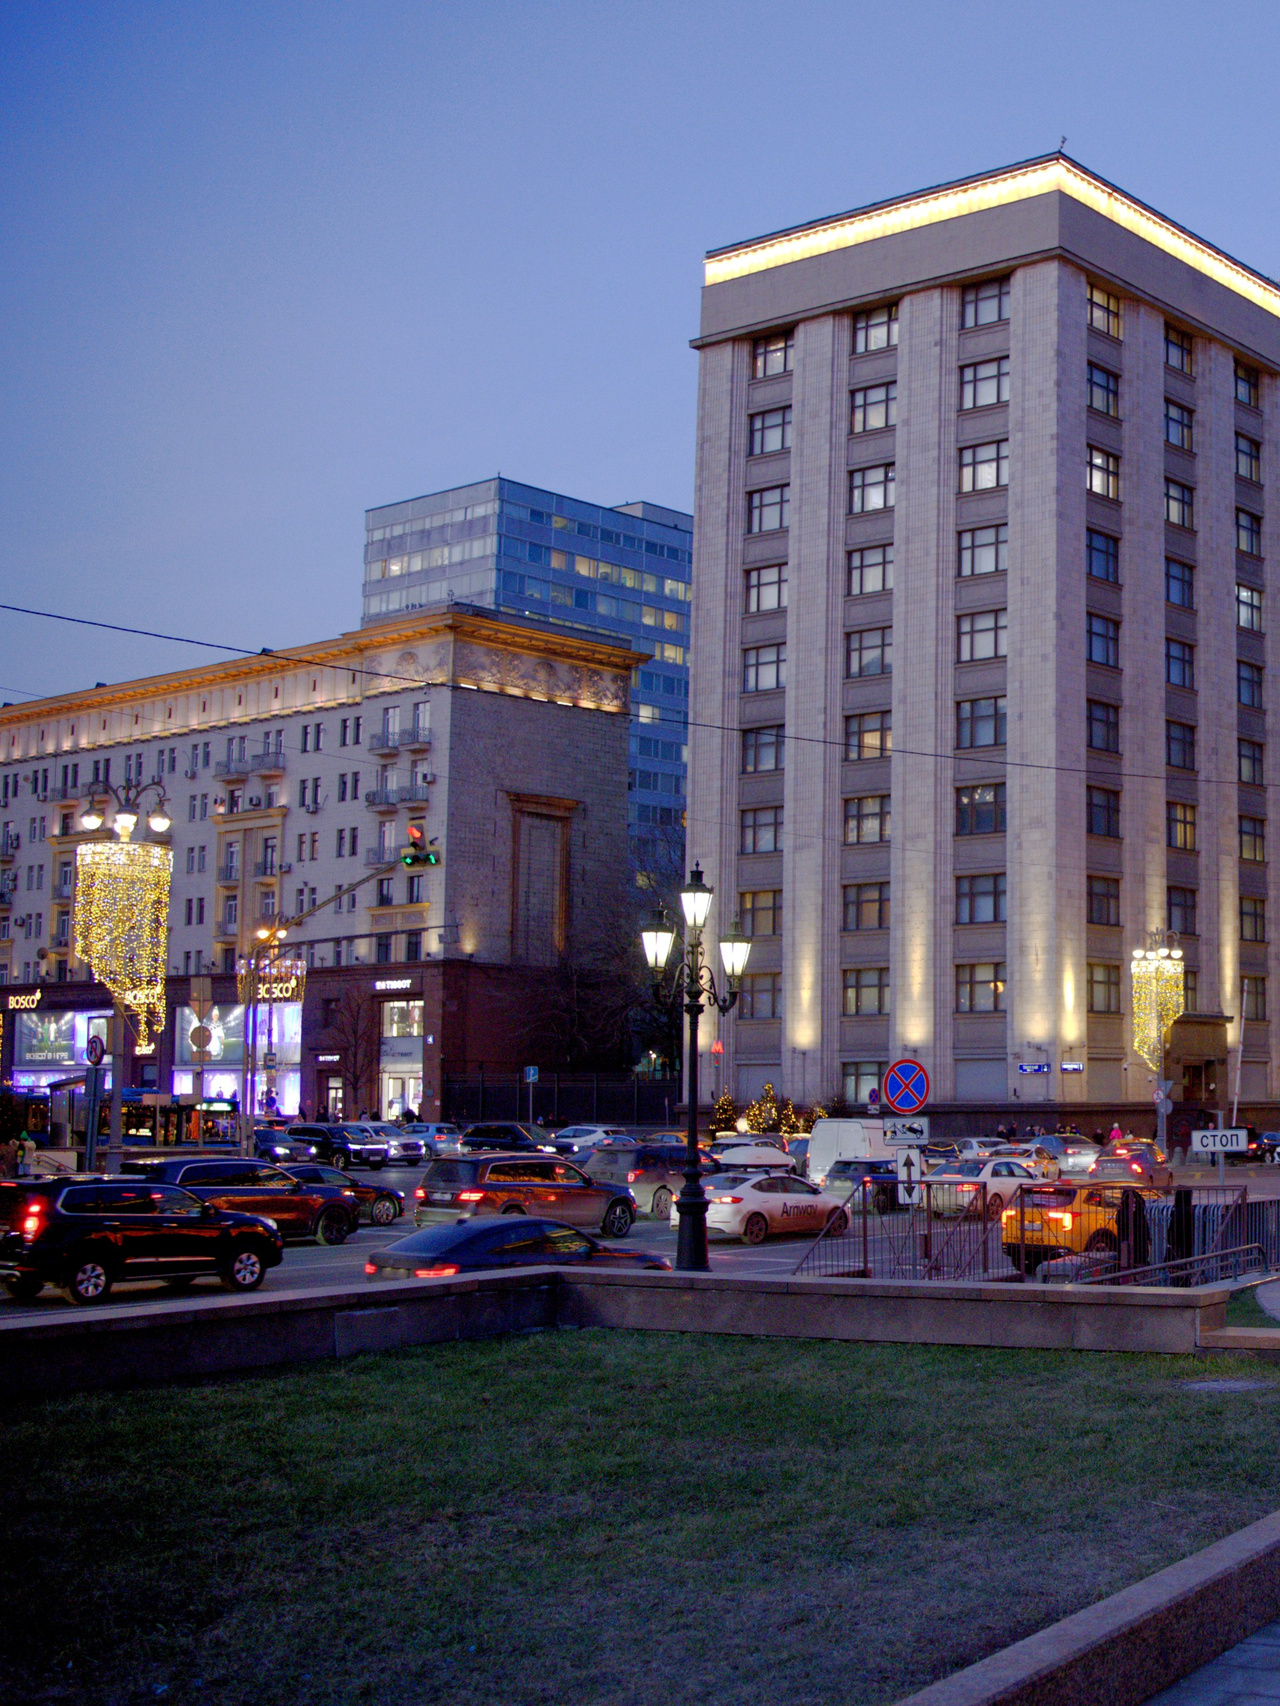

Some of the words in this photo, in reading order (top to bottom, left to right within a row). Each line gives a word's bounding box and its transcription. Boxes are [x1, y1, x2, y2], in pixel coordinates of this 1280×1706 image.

[8, 995, 38, 1009] BOSCO
[1200, 1134, 1239, 1148] СТОП
[781, 1202, 818, 1217] Amway
